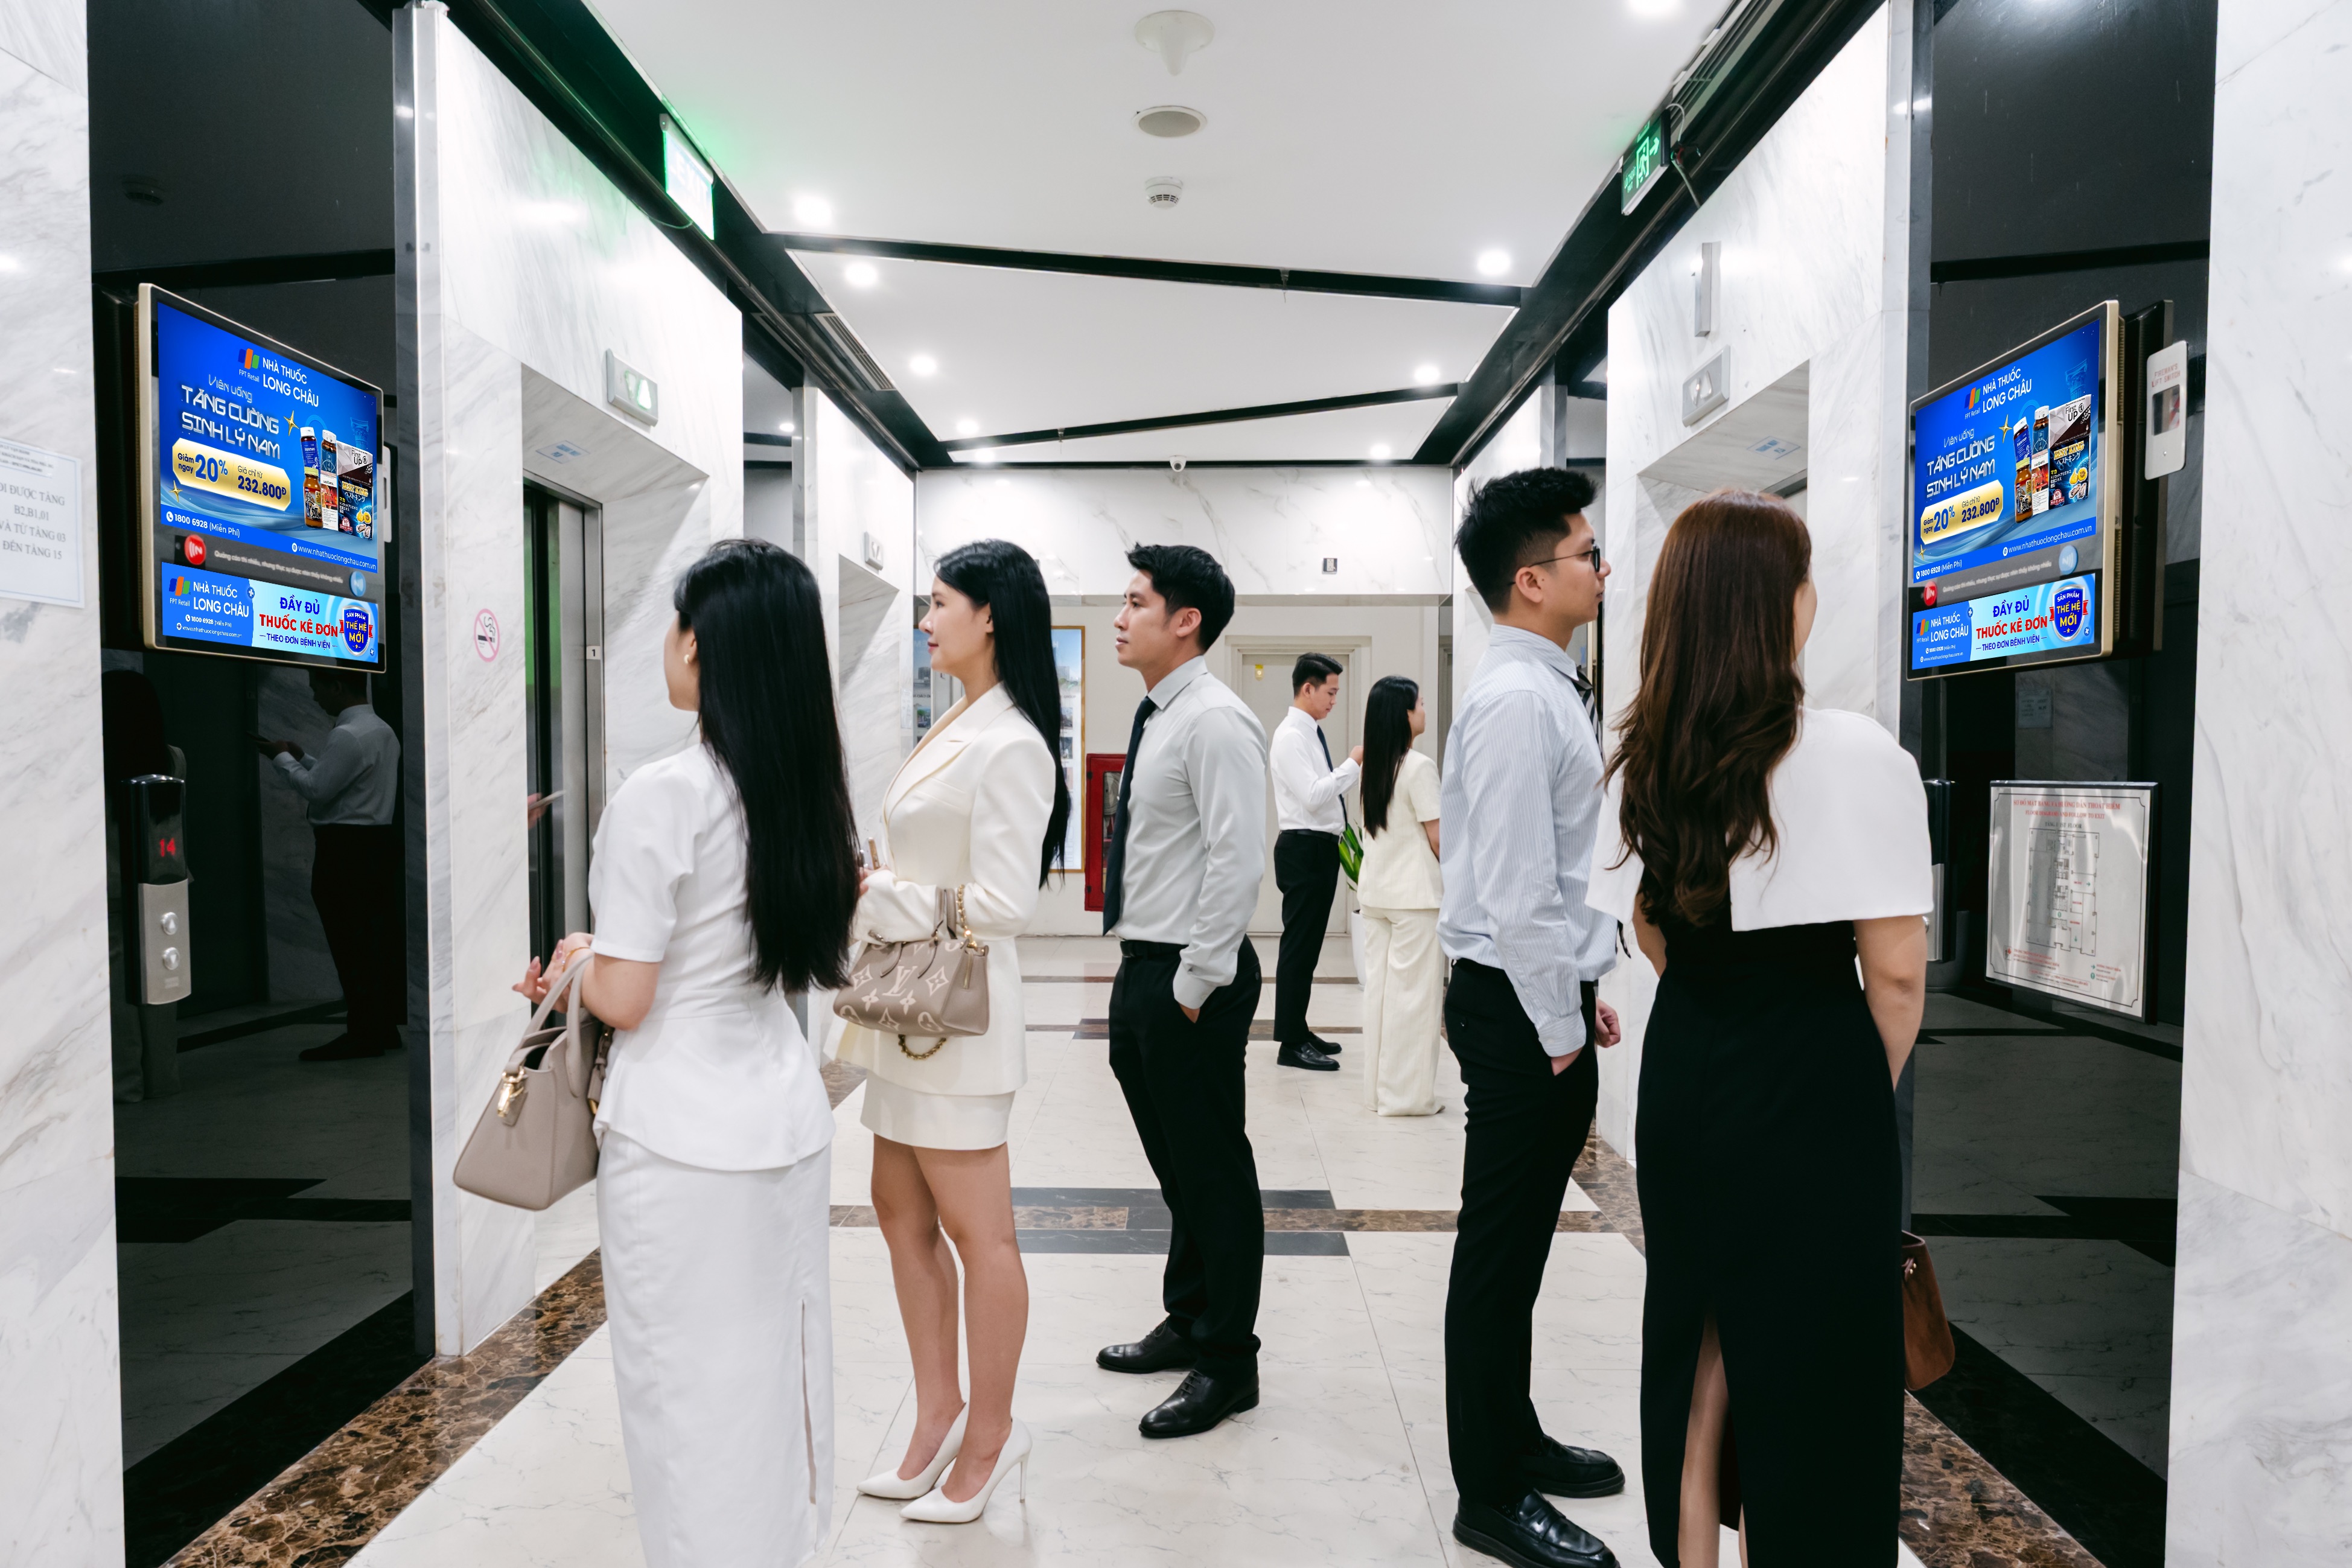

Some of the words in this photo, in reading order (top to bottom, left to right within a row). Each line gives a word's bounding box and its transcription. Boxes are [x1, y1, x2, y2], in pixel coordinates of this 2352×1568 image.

[247, 372, 260, 383] Retail
[263, 357, 279, 373] NHÀ
[281, 365, 307, 384] THUỐC
[2155, 363, 2178, 377] FIREMAN'S
[2164, 371, 2181, 383] SWITCH
[208, 374, 229, 392] Viên
[231, 386, 252, 403] uống
[1983, 378, 1997, 395] NHÀ
[1998, 366, 2021, 387] THUỐC
[263, 374, 291, 396] LONG
[293, 387, 319, 407] CHÂU
[1983, 392, 2006, 413] LONG
[2007, 379, 2032, 401] CHÂU
[182, 384, 226, 416] TĂNG
[1971, 407, 1981, 418] Retail
[2065, 405, 2076, 414] First
[2068, 410, 2078, 421] UP
[182, 412, 223, 441] SINH
[226, 424, 245, 447] LÝ
[248, 435, 280, 459] NAM
[1943, 435, 1958, 448] Viên
[1959, 429, 1975, 442] uống
[177, 453, 194, 464] Giảm
[351, 450, 361, 459] First
[178, 463, 194, 474] ngay
[195, 454, 228, 483] 20%
[238, 466, 247, 474] Giá
[1927, 452, 1955, 476] TĂNG
[1927, 477, 1952, 498] SINH
[1954, 467, 1968, 488] LÝ
[1970, 459, 1995, 482] NAM
[10, 485, 37, 500] ĐƯỢC
[14, 505, 49, 521] B2,B1,01
[1934, 505, 1955, 534] 20%
[174, 513, 191, 524] 1800
[192, 518, 208, 529] 6928
[209, 522, 227, 534] (Miễn
[228, 526, 240, 538] Phí)
[1923, 518, 1934, 526] Giảm
[57, 532, 66, 543] 03
[2009, 525, 2092, 553] www.nhathuoclongchau.com.vn
[2, 539, 23, 553] ĐẾN
[53, 550, 62, 560] 15
[298, 544, 377, 570] www.nhathuoclongchau.com.vn
[1941, 562, 1953, 573] (Miễn
[1953, 559, 1962, 569] Phí)
[193, 581, 210, 594] NHÀ
[211, 584, 238, 598] THUỐC
[2057, 592, 2066, 602] SẢN
[2067, 590, 2080, 599] PHẨM
[193, 596, 221, 613] LONG
[223, 601, 249, 617] CHÂU
[280, 594, 302, 612] ĐẦY
[304, 599, 320, 614] ĐỦ
[1993, 600, 2013, 618] ĐẦY
[2015, 595, 2030, 613] ĐỦ
[2056, 601, 2070, 614] THẾ
[2071, 600, 2081, 613] HỆ
[354, 611, 366, 620] PHẨM
[1931, 616, 1941, 628] NHÀ
[1942, 611, 1960, 625] THUỐC
[2060, 612, 2077, 628] MỚI
[260, 613, 297, 631] THUỐC
[300, 618, 313, 634] KÊ
[315, 623, 338, 637] ĐƠN
[345, 619, 358, 630] THẾ
[359, 622, 367, 633] HỆ
[1931, 629, 1948, 642] LONG
[1950, 623, 1969, 639] CHÂU
[1976, 620, 2007, 640] THUỐC
[2010, 617, 2022, 634] KÊ
[2024, 614, 2047, 631] ĐƠN
[267, 633, 284, 642] THEO
[285, 635, 299, 645] ĐƠN
[300, 637, 316, 648] BỆNH
[317, 640, 331, 651] VIỆN
[349, 631, 364, 643] MỚI
[1982, 642, 1997, 651] THEO
[1997, 640, 2009, 649] ĐƠN
[2010, 636, 2025, 648] BỆNH
[2026, 634, 2040, 646] VIỆN
[159, 838, 176, 857] 14
